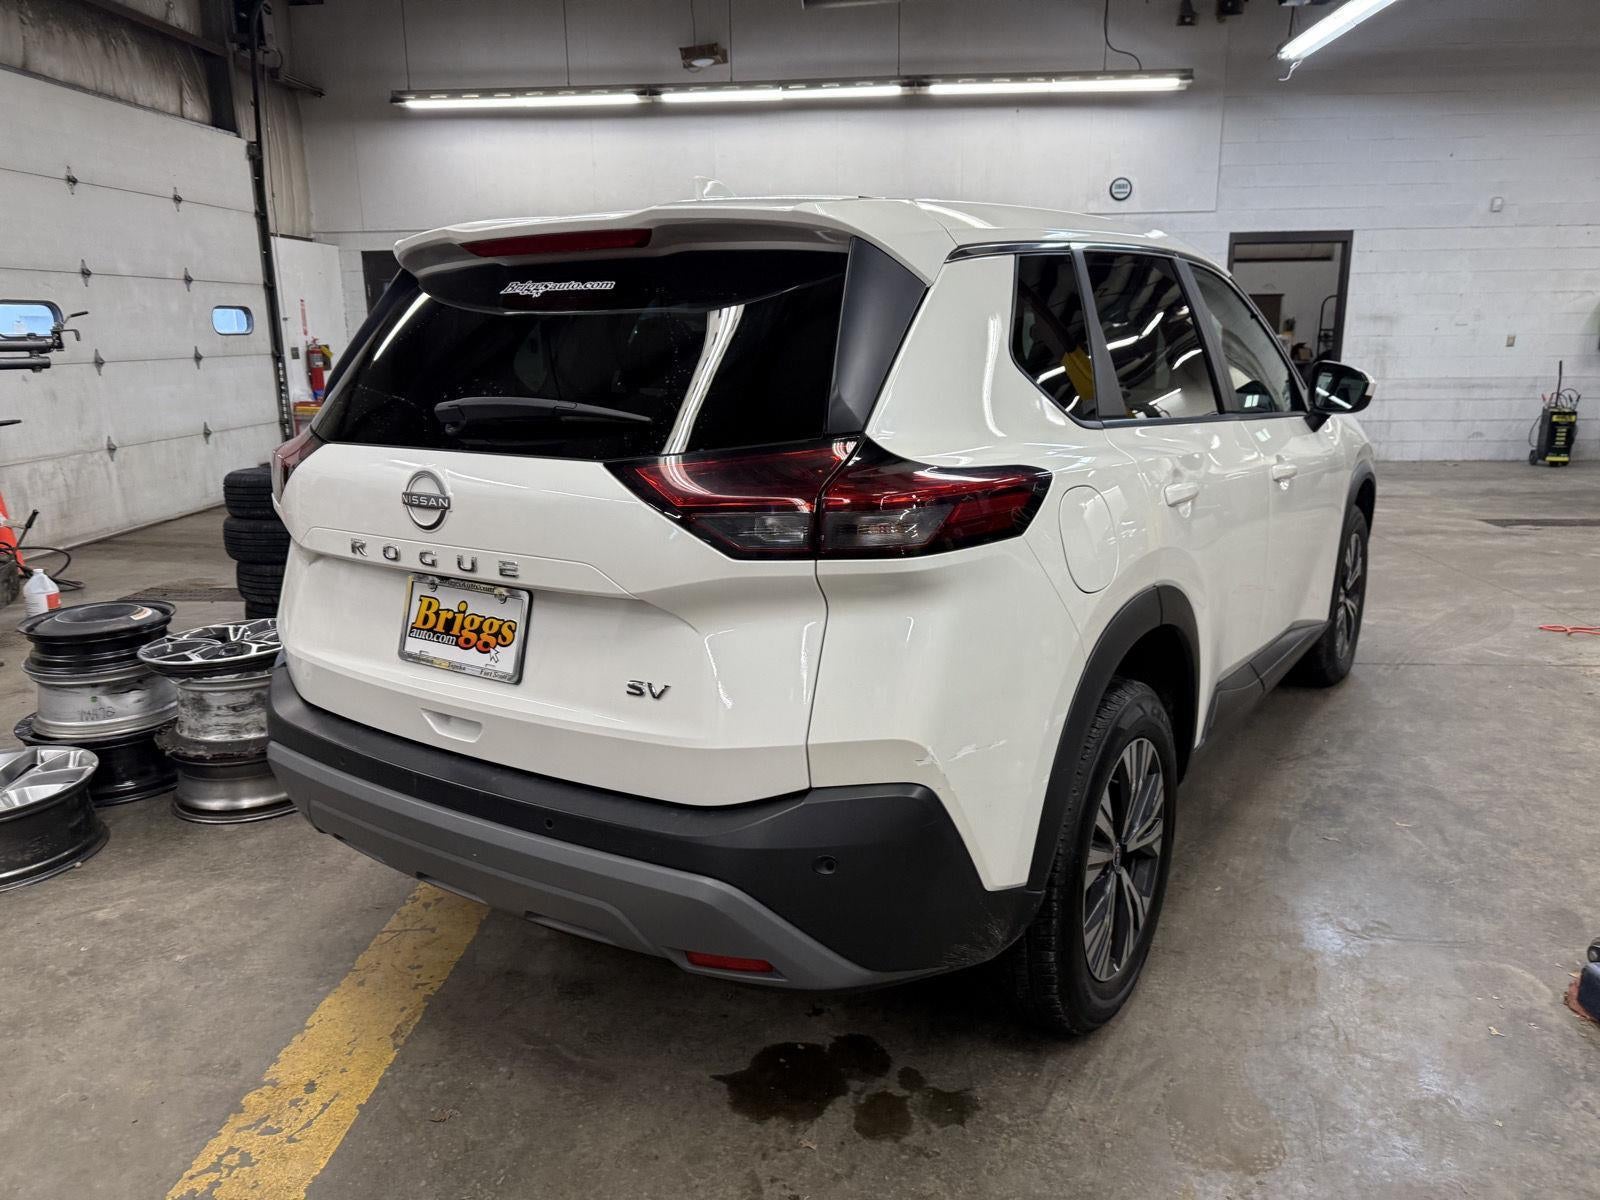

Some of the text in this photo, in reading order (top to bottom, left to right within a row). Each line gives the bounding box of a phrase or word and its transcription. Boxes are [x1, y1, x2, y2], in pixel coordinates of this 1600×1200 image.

[402, 494, 449, 507] NISSAN
[350, 538, 519, 578] ROGUE
[410, 594, 518, 655] Briggs
[410, 627, 457, 646] auto.com
[626, 679, 672, 700] SV
